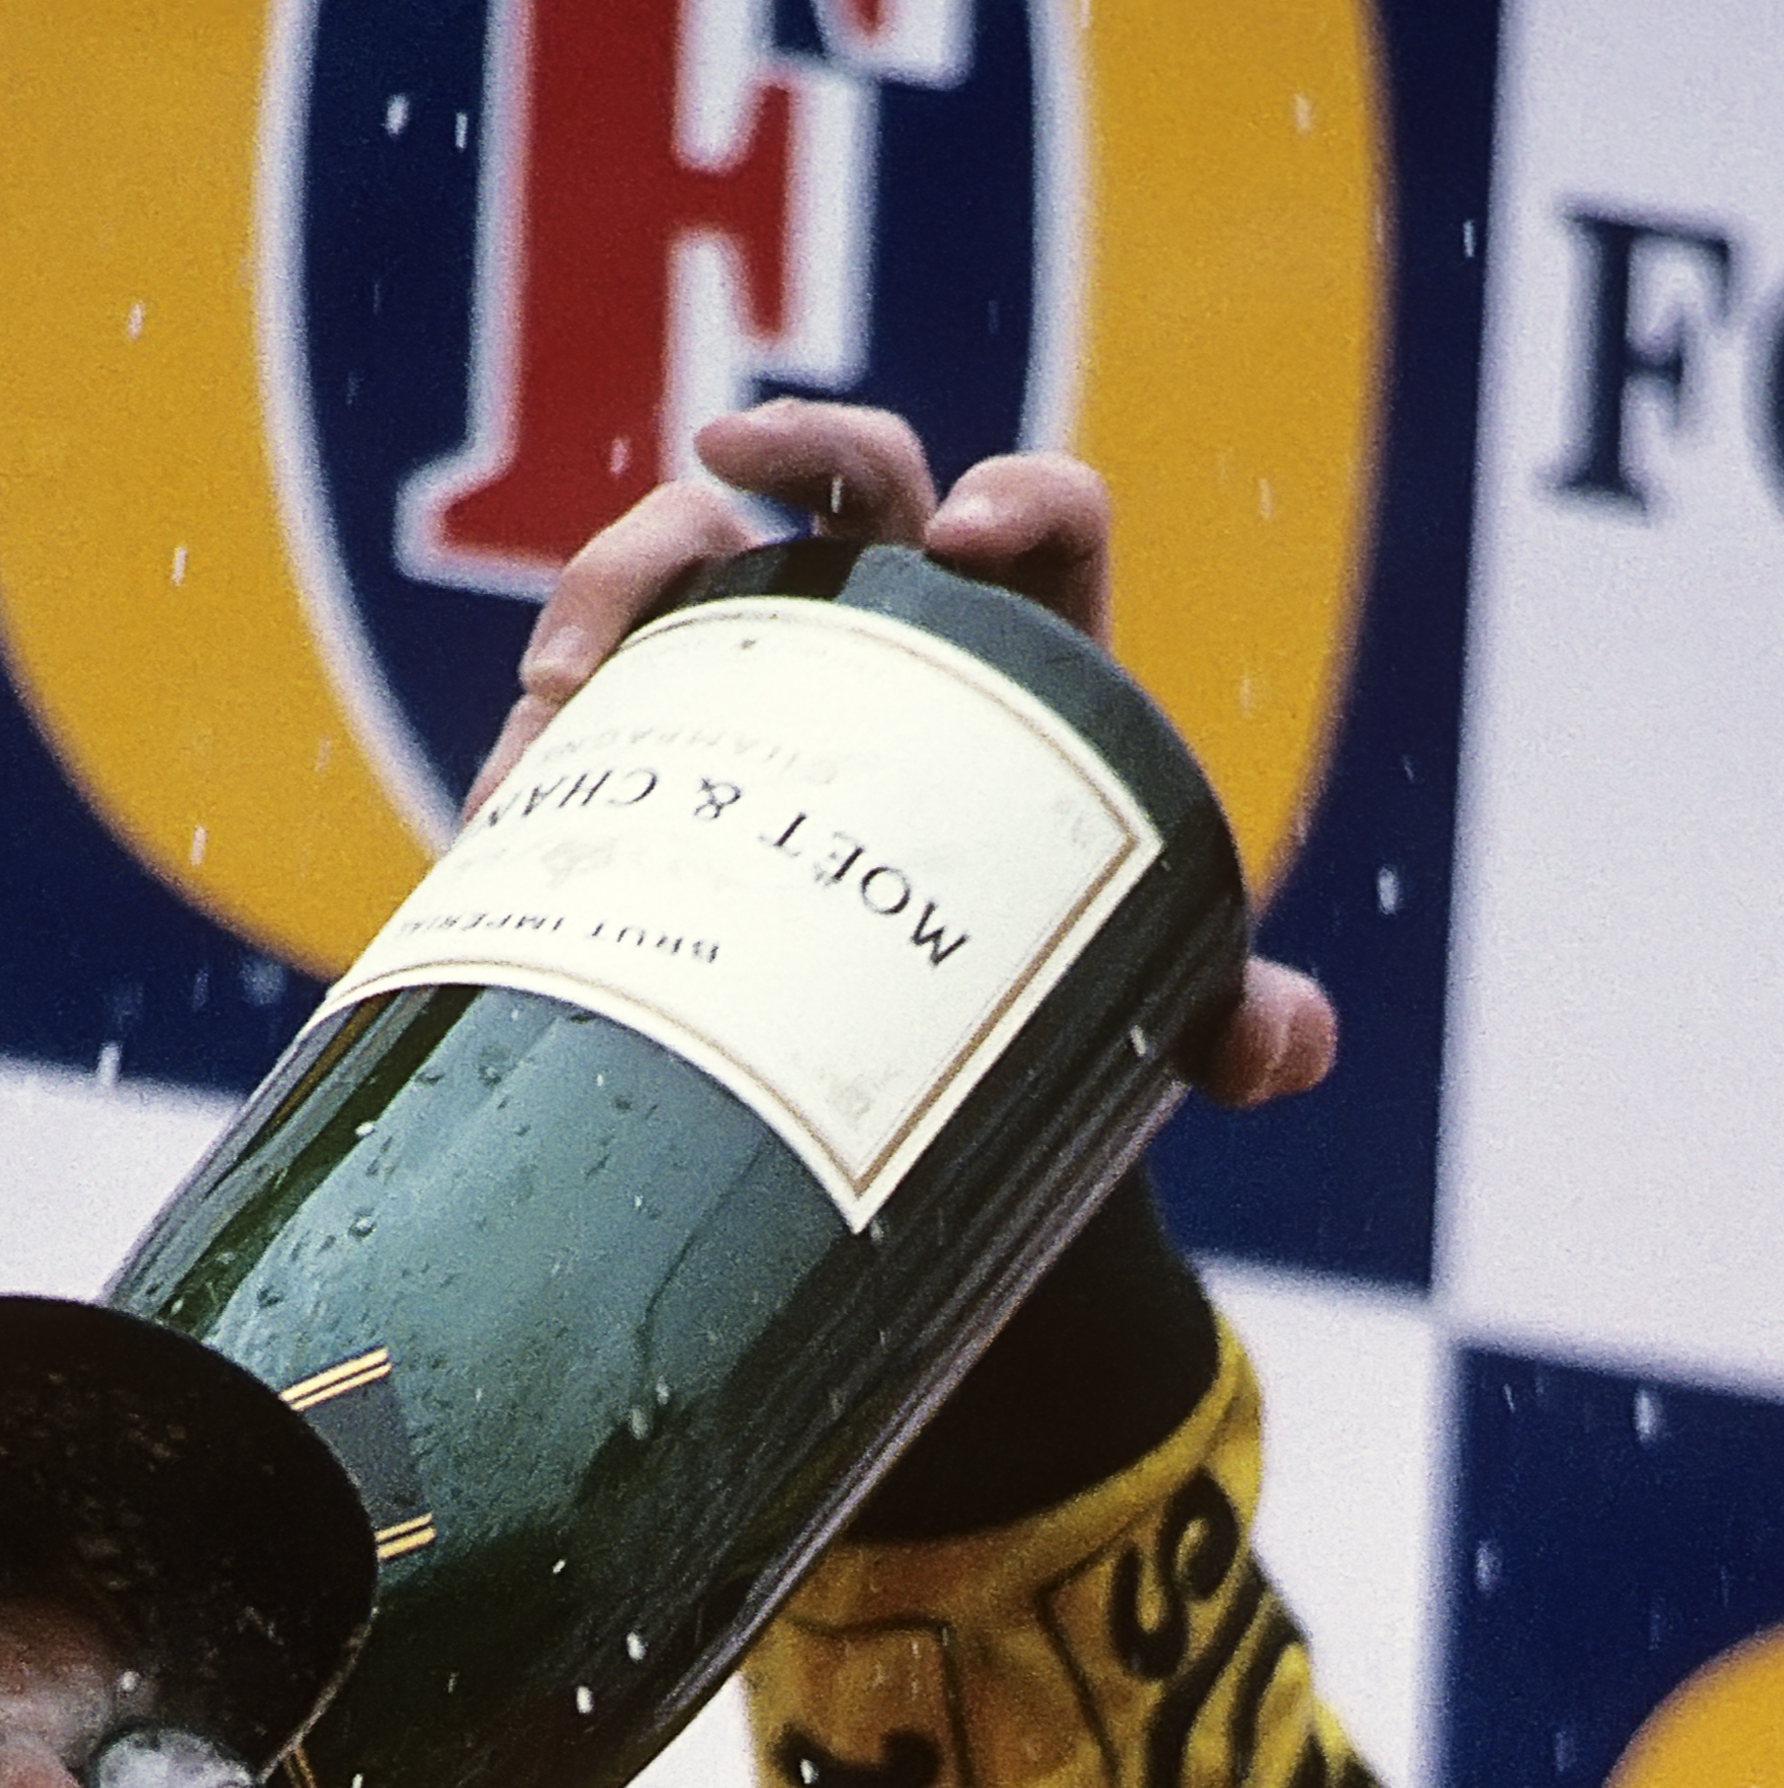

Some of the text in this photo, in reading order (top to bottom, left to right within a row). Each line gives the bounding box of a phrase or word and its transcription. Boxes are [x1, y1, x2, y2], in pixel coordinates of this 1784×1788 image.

[693, 773, 745, 821] &
[759, 809, 972, 967] MOËT
[586, 921, 722, 966] BRUT
